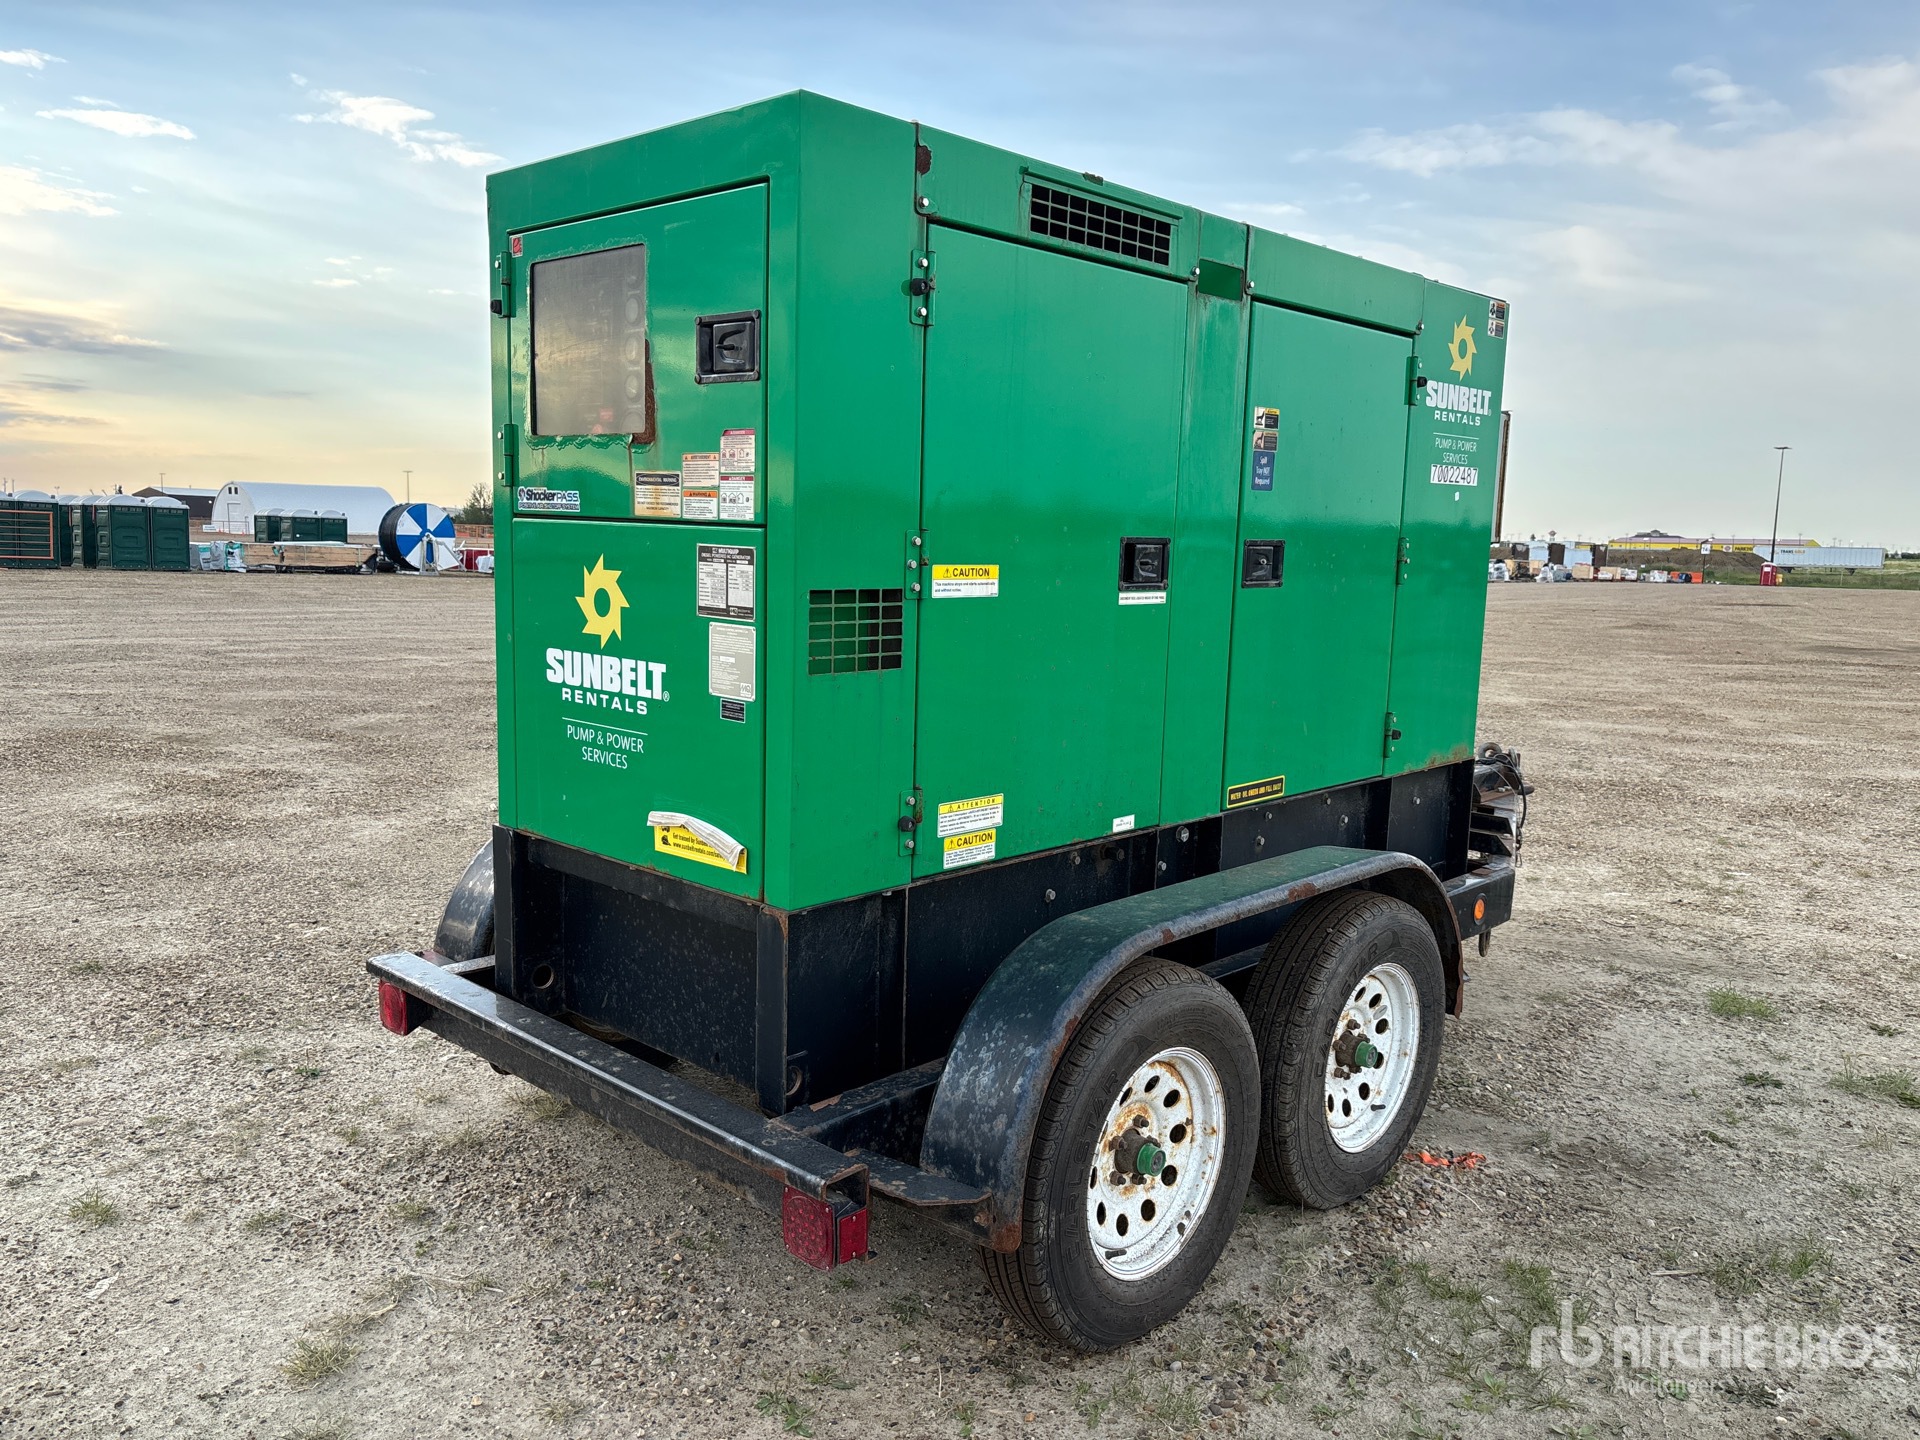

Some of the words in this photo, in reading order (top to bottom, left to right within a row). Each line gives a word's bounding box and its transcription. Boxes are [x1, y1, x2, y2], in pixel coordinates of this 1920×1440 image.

[1434, 410, 1480, 426] RENTALS
[1435, 438, 1451, 449] PUMP
[1452, 440, 1457, 450] &
[1457, 441, 1477, 452] POWER
[1443, 452, 1468, 465] SERVICES
[1432, 465, 1478, 485] 70022487
[952, 567, 990, 578] CAUTION
[562, 688, 648, 715] RENTALS
[567, 725, 595, 743] PUMP
[597, 731, 604, 745] &
[607, 733, 644, 753] POWER
[582, 746, 628, 769] SERVICES
[957, 798, 996, 810] ATTENTION
[957, 832, 993, 847] CAUTION
